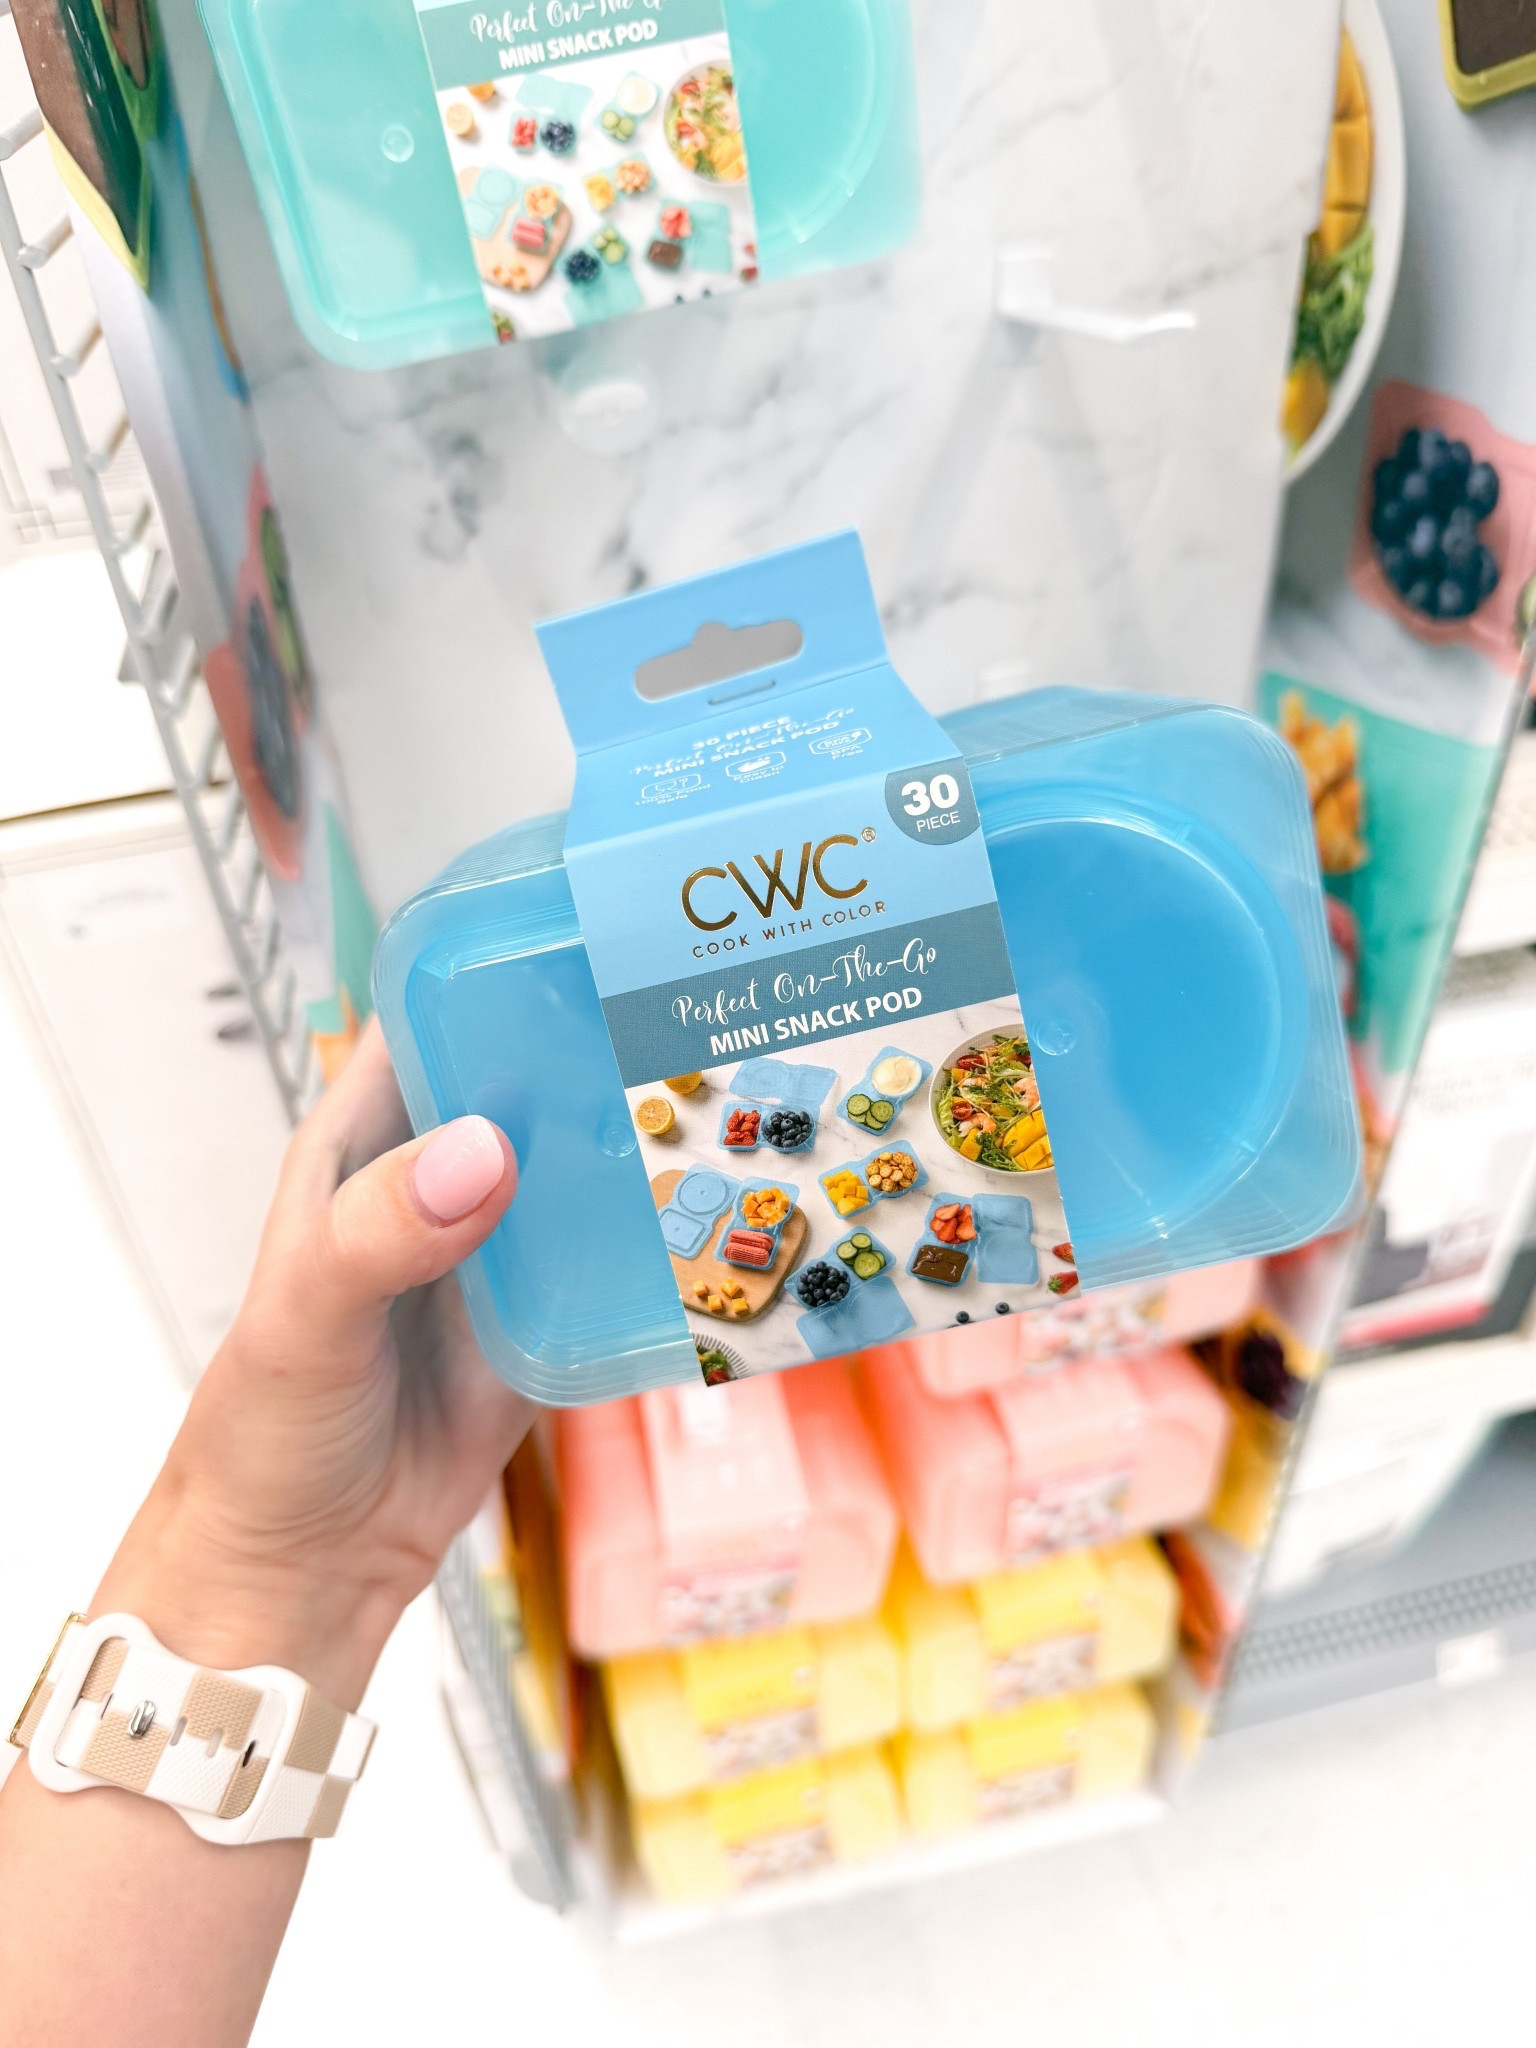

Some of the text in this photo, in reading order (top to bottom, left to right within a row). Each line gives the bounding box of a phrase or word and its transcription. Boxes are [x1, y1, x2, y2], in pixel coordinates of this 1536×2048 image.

[470, 1, 539, 44] Perfect
[499, 18, 658, 70] MINI SNACK POD
[653, 720, 840, 778] MINI SNACK POD
[692, 715, 791, 751] 30 PIECE
[901, 774, 959, 816] 30
[916, 811, 960, 832] PIECE
[692, 901, 886, 959] COOK WITH COLOR
[671, 937, 937, 1027] Perfect On-The-Go
[709, 986, 923, 1056] MINI SNACK POD
